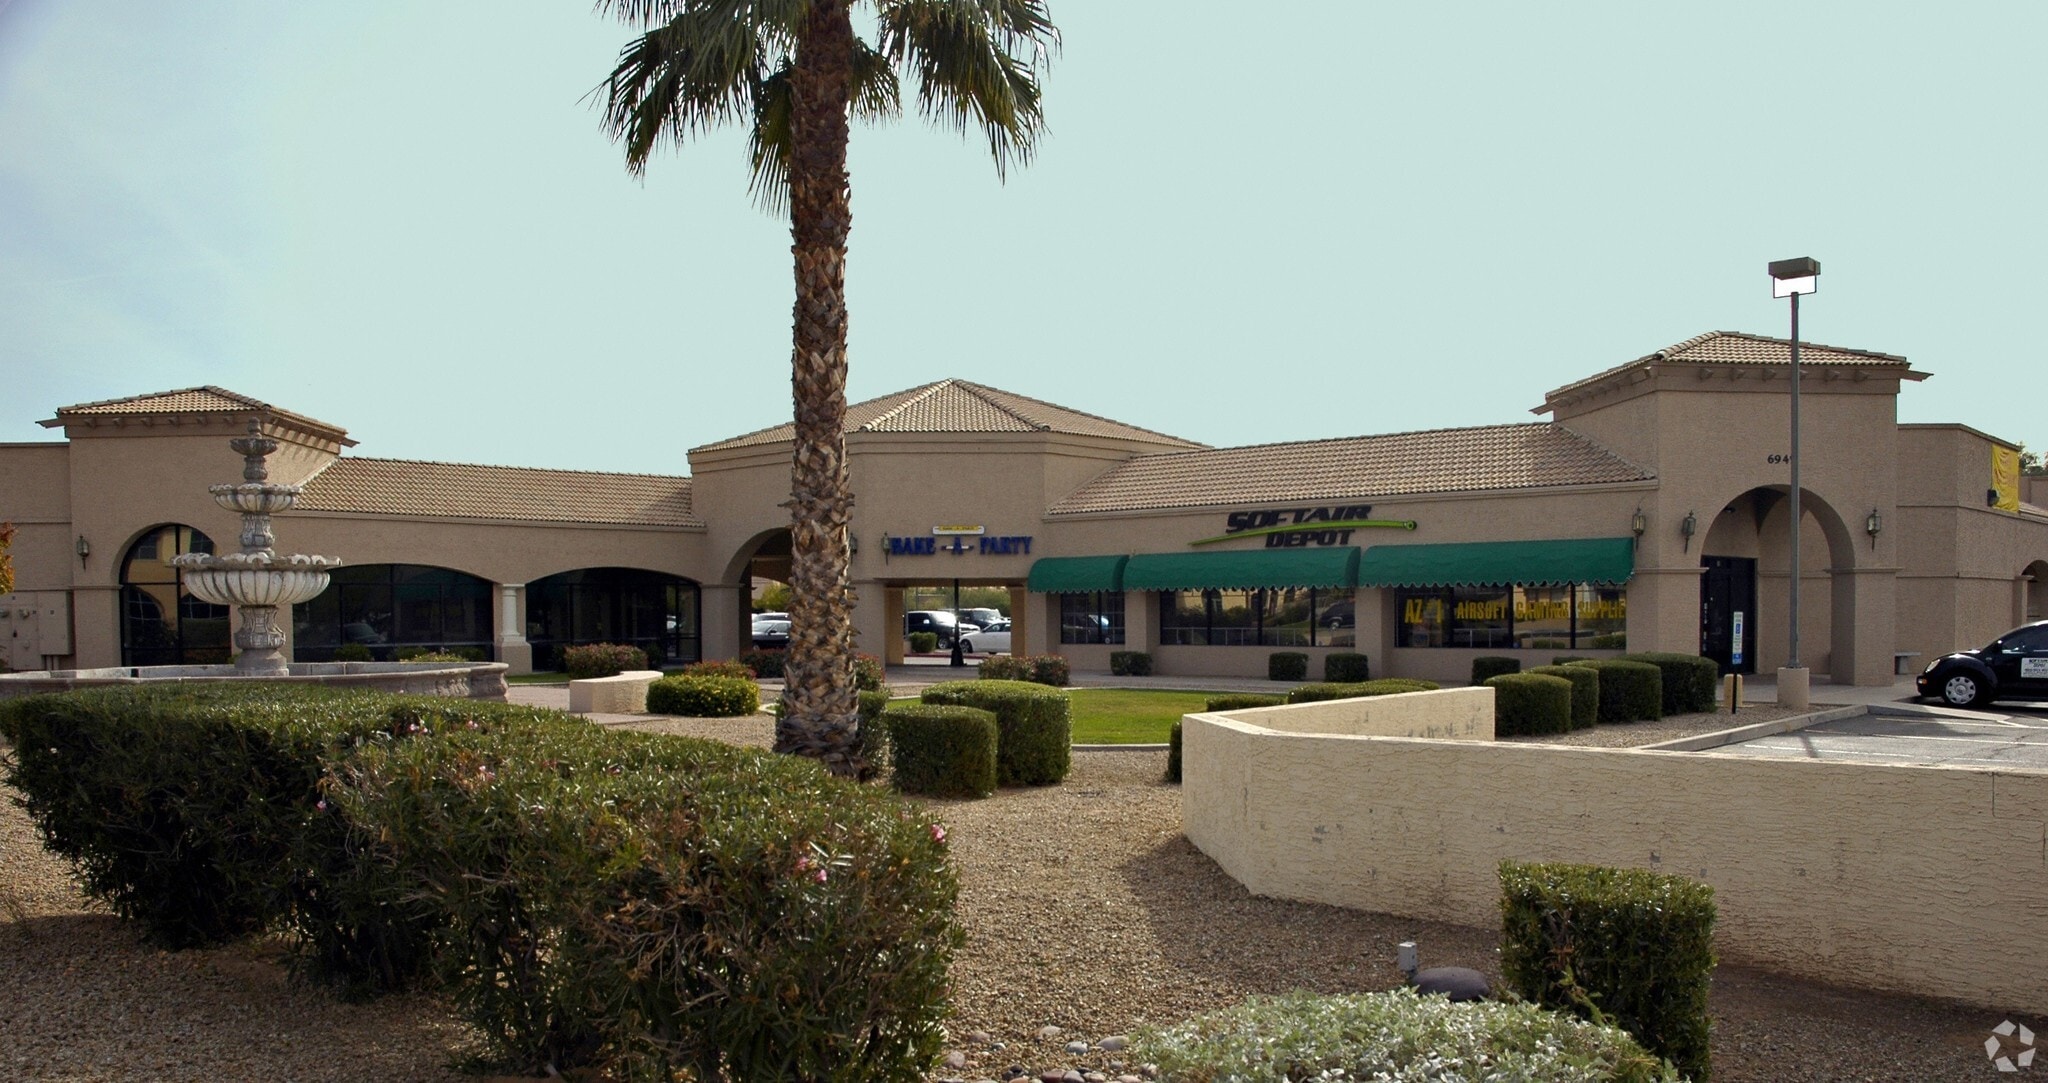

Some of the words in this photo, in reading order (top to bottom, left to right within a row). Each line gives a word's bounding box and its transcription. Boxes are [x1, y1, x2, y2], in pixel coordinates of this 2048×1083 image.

[1767, 454, 1792, 464] 694
[1225, 505, 1372, 533] SOFTAIR
[890, 537, 936, 555] BAKE
[979, 536, 1033, 555] PARTY
[1265, 529, 1355, 548] DEPOT
[1404, 599, 1423, 623] AZ
[1457, 601, 1507, 619] AIRSOFT
[1577, 600, 1626, 619] SUPPLIE
